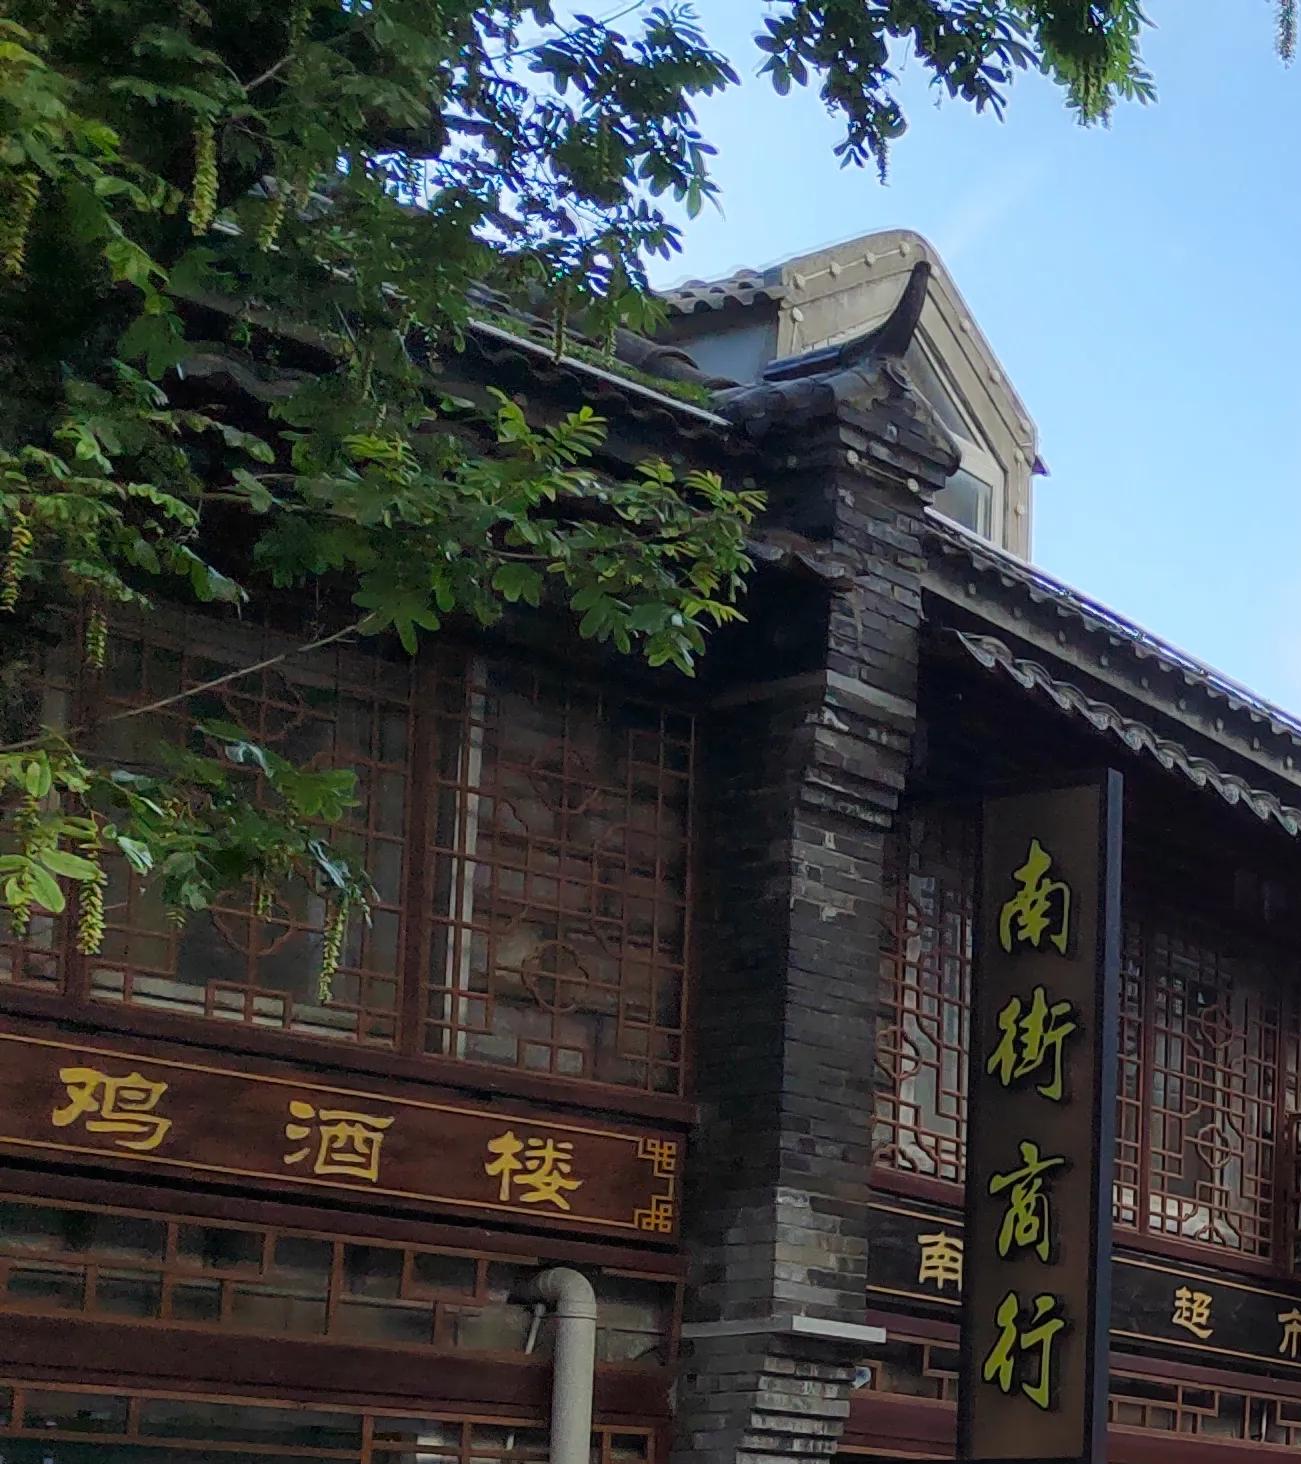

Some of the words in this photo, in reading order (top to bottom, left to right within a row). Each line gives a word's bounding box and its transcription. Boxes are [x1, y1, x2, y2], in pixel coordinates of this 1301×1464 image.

[51, 1066, 584, 1211] 鸡酒楼
[986, 837, 1077, 1411] 南街商行
